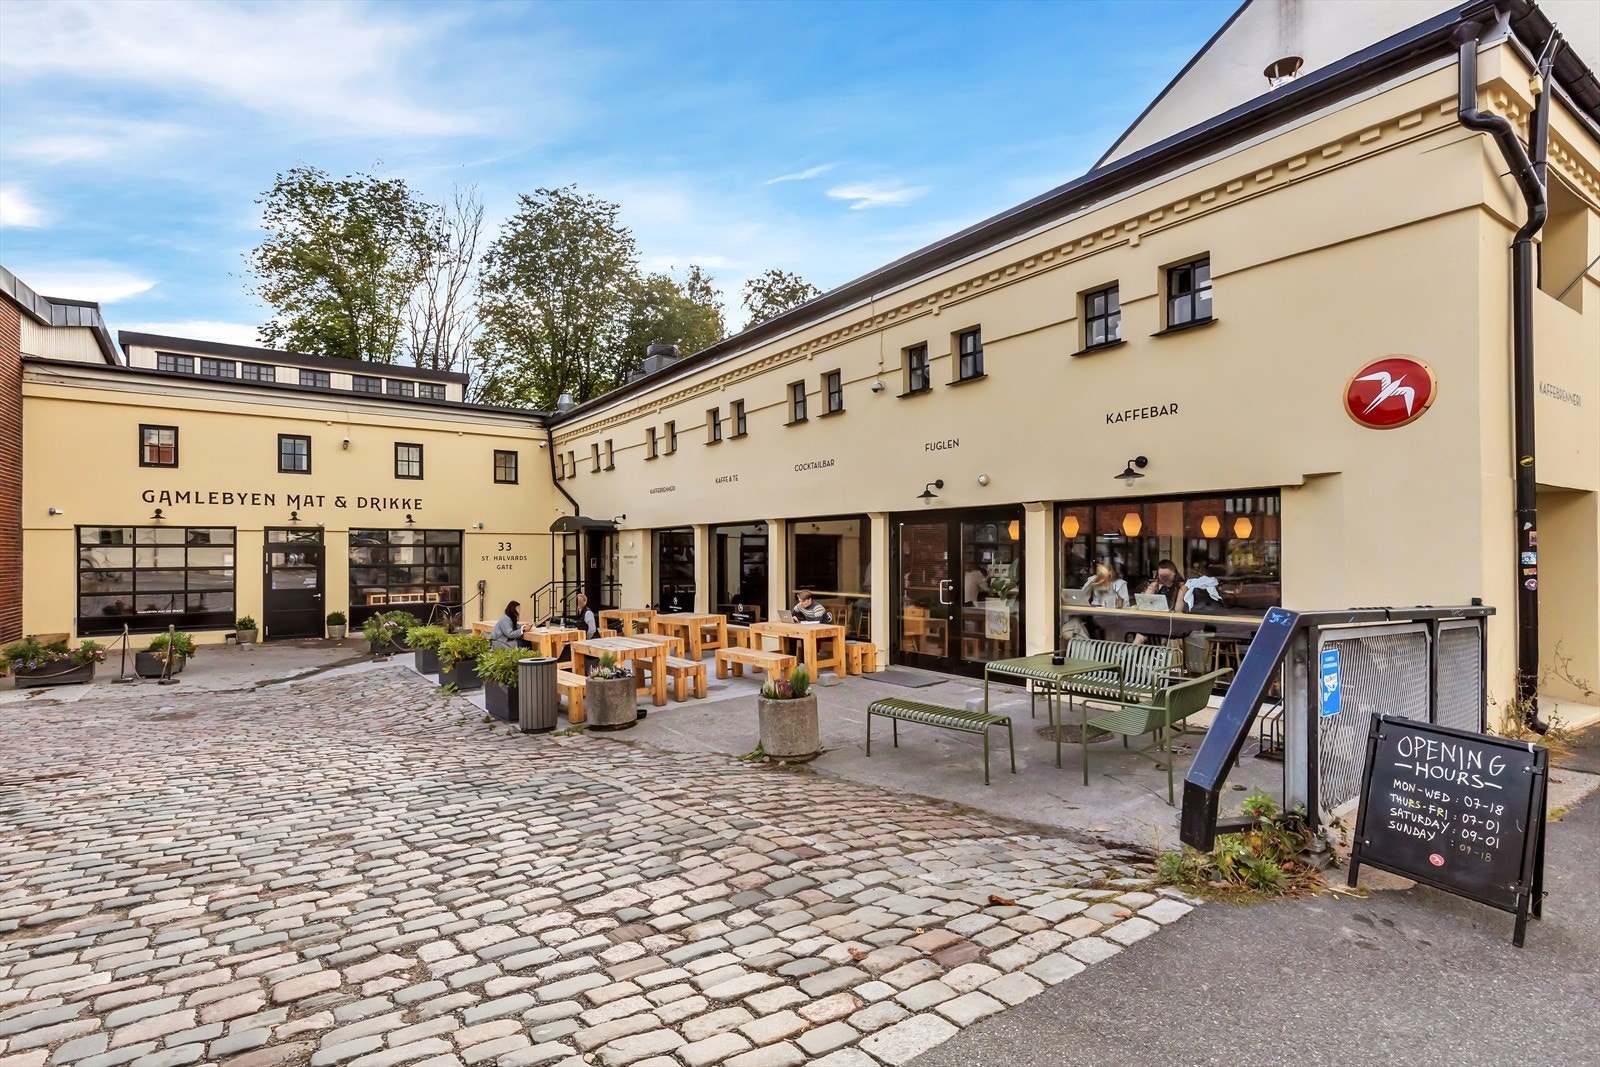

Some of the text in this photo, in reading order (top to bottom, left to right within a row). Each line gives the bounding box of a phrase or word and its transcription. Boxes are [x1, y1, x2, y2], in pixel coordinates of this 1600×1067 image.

[1539, 380, 1582, 407] KAFFEBRENNERI
[1106, 403, 1179, 424] KAFFEBAR
[925, 438, 960, 452] FUGLEN
[794, 458, 835, 472] COCKTAILBAR
[141, 489, 423, 511] GAMLEBYEN MAT & DRIKKE
[497, 541, 512, 552] 33
[1397, 735, 1506, 776] OPENING
[1388, 820, 1436, 842] SUNDAY
